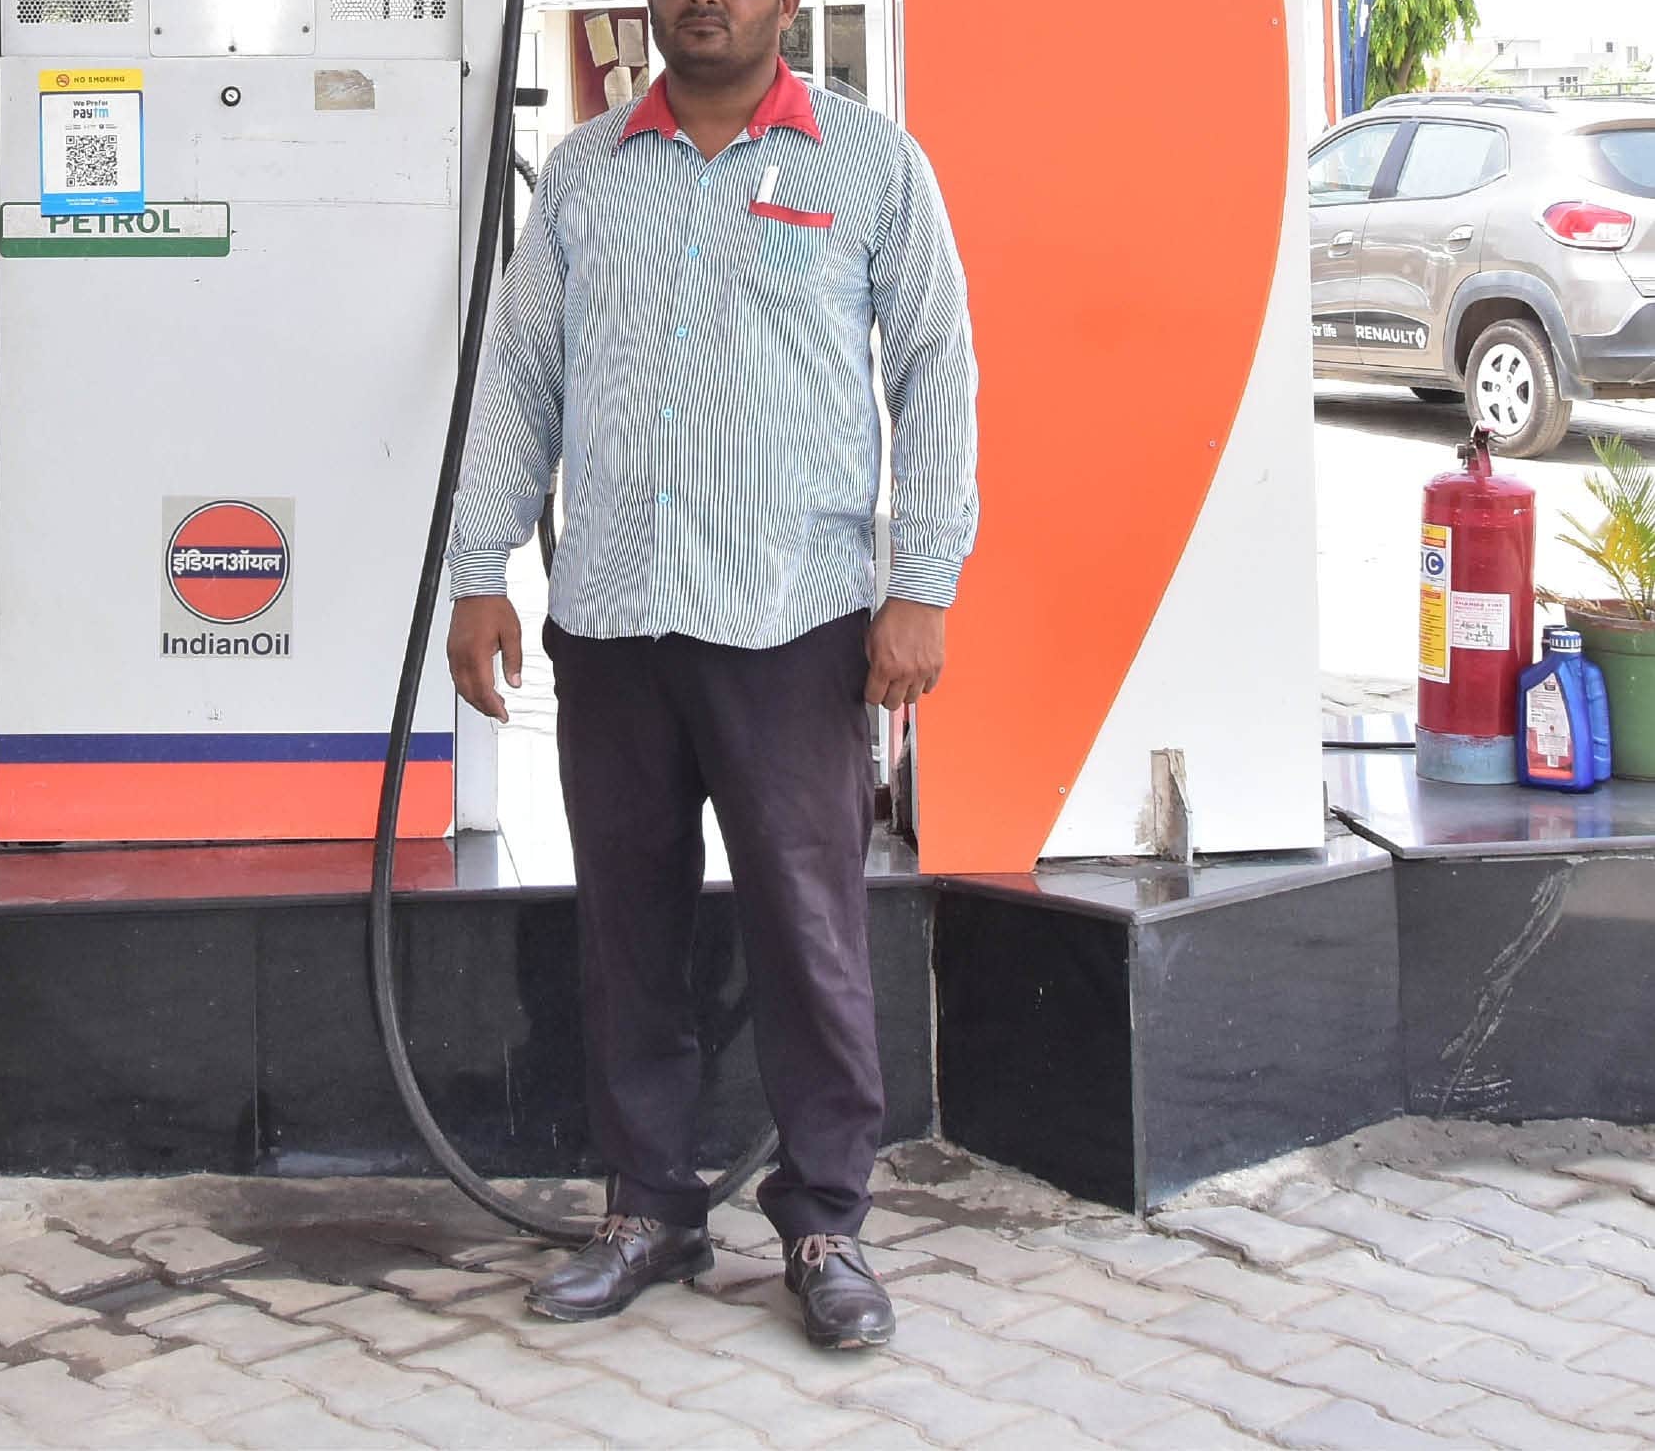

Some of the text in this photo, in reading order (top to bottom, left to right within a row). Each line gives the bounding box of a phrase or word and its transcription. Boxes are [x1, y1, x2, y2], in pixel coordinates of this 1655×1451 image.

[49, 208, 181, 234] PETROL
[1322, 323, 1337, 337] life
[1354, 324, 1415, 345] RENAULT
[172, 549, 283, 575] इंडियनऑयल
[162, 632, 290, 655] IndianOil
